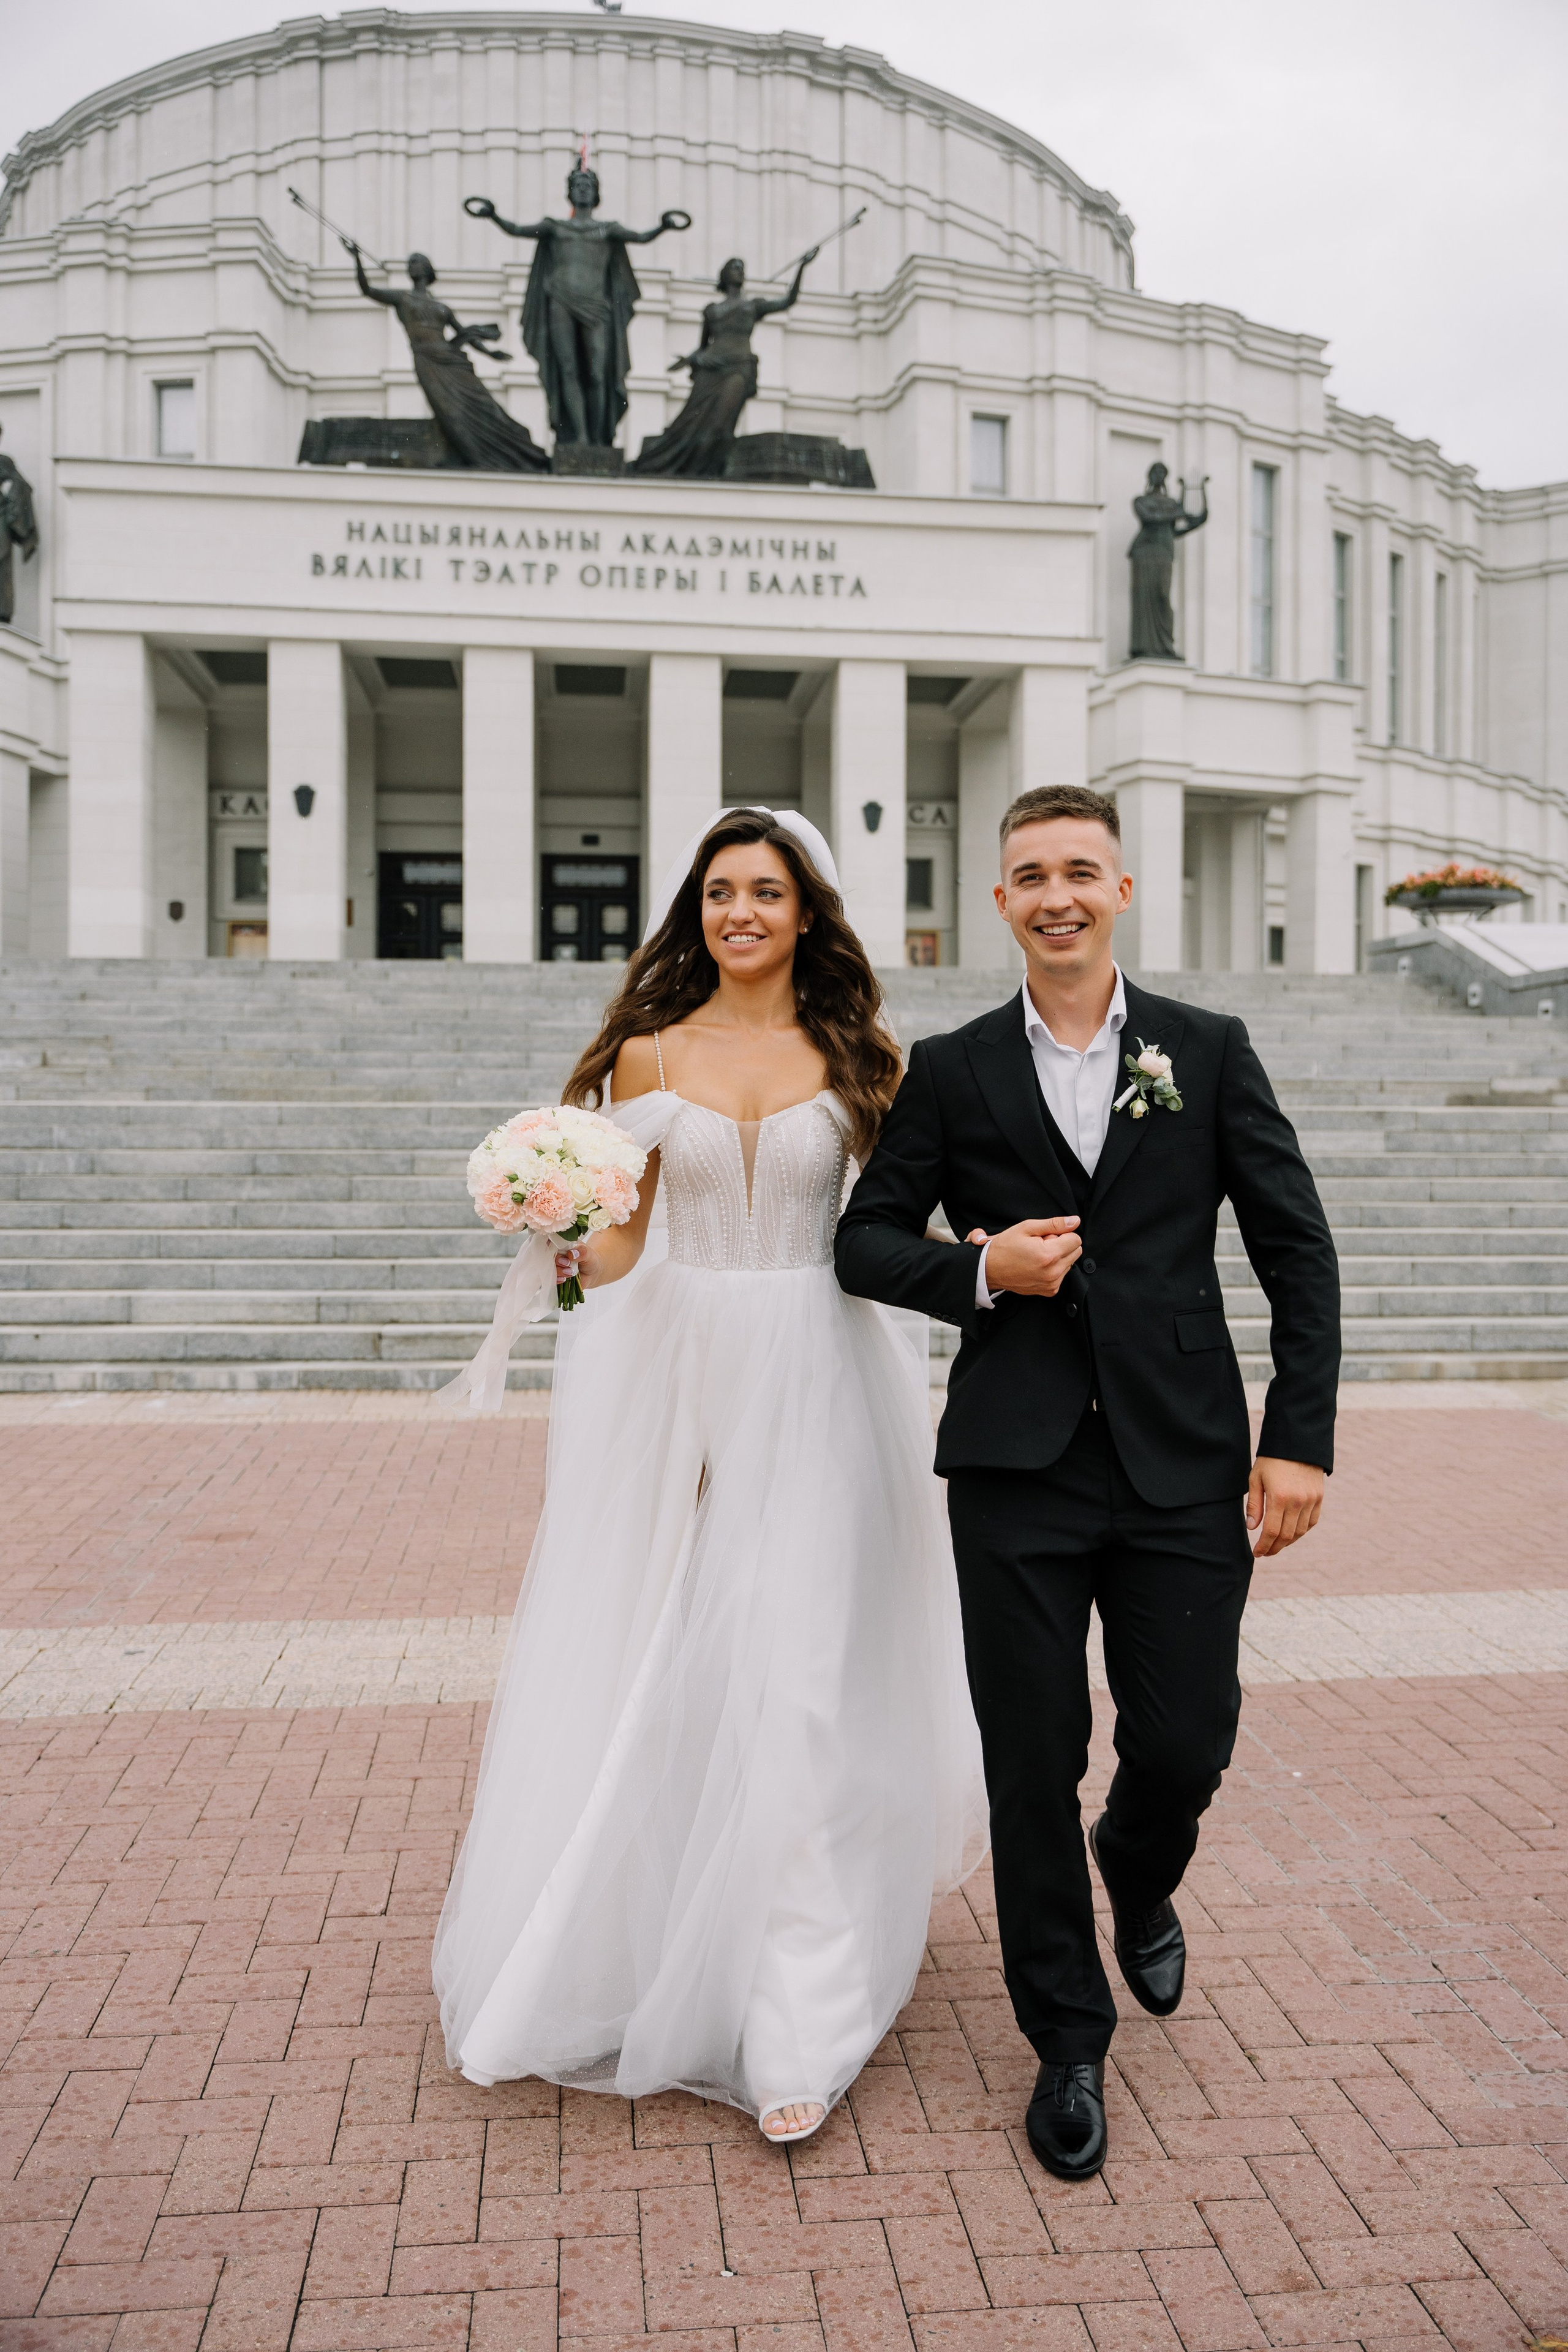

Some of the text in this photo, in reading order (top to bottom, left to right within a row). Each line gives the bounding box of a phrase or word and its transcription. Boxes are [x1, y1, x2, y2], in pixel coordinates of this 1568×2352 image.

[347, 521, 836, 561] НАЦЫЯНАЛЬНЫ АКАДЭМІЧНЫ
[311, 554, 421, 580] ВЯЛІКІ
[449, 559, 559, 585] ТЭАТР
[579, 564, 697, 592] ОПЕРЫ
[747, 571, 867, 598] БАЛЕТА
[219, 796, 268, 815] КА
